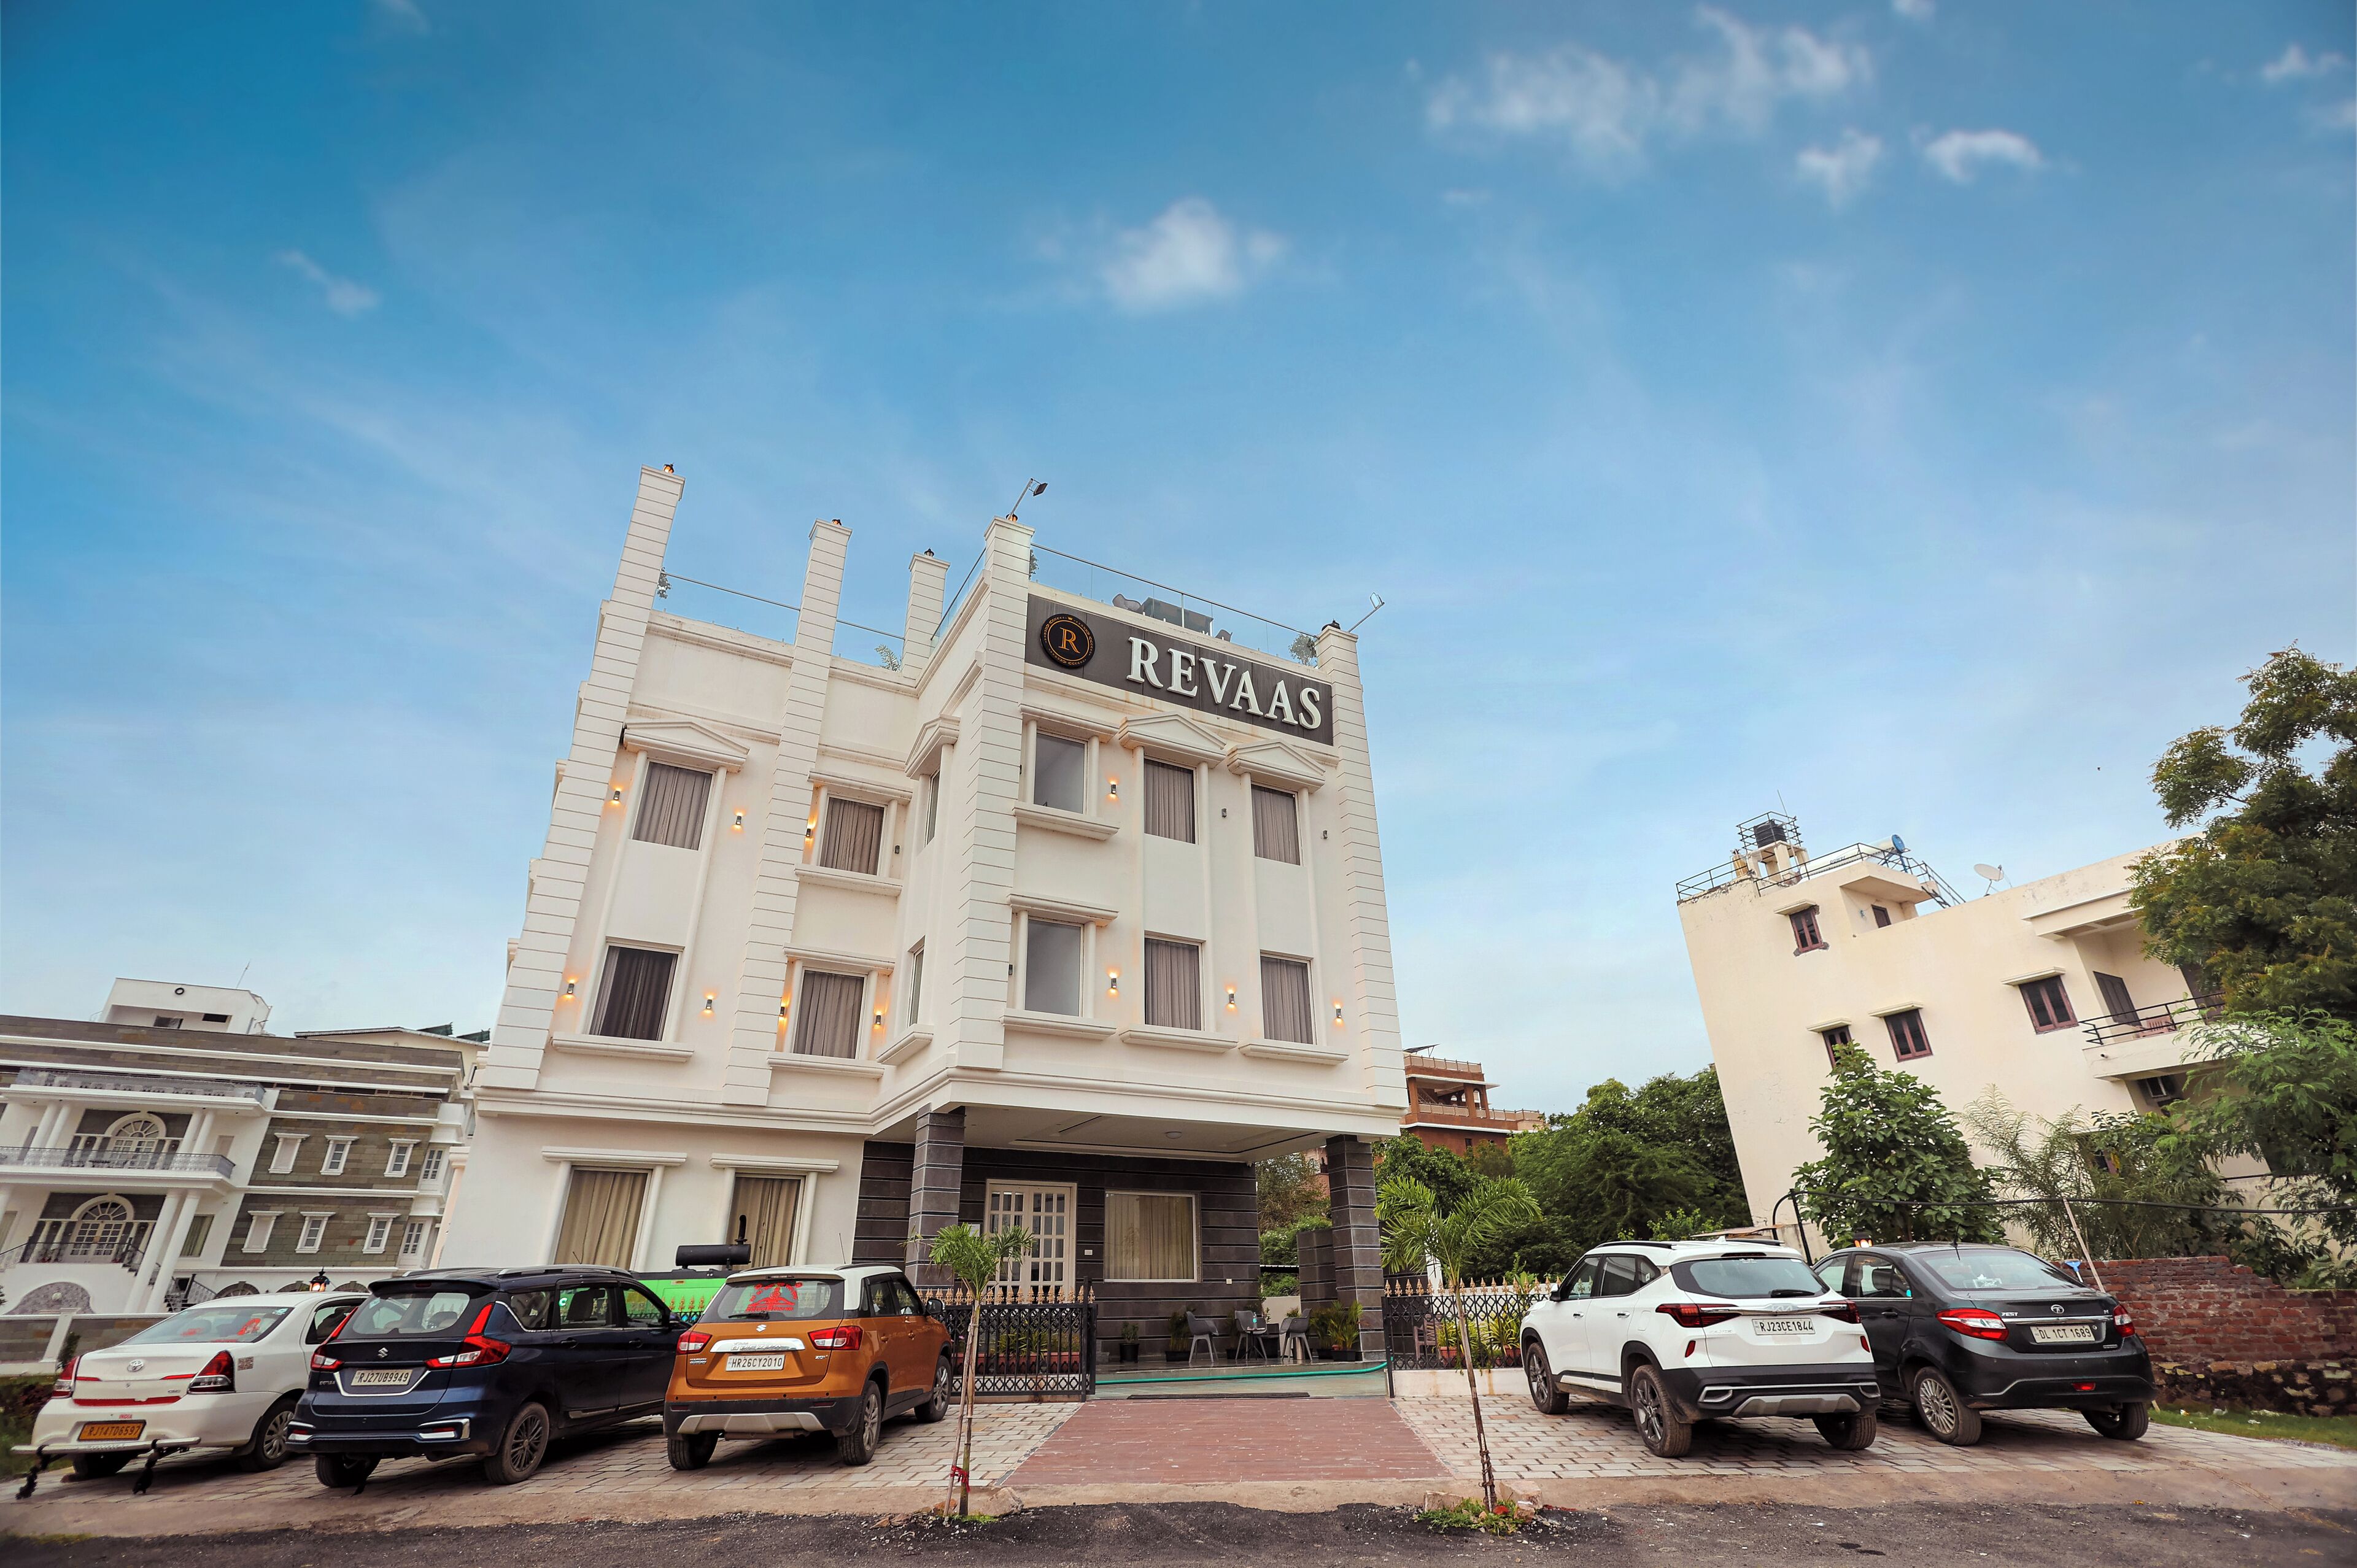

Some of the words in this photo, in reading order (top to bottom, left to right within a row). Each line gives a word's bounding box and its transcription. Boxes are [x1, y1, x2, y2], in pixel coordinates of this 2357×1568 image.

[1058, 627, 1080, 654] R
[1126, 636, 1321, 730] REVAAS
[1759, 1320, 1813, 1332] RJ23CE1844
[2070, 1329, 2091, 1338] 1689
[731, 1358, 782, 1368] HR26CY2010
[358, 1372, 409, 1383] RJ27UB9949
[88, 1424, 141, 1436] RJ14TD6597
